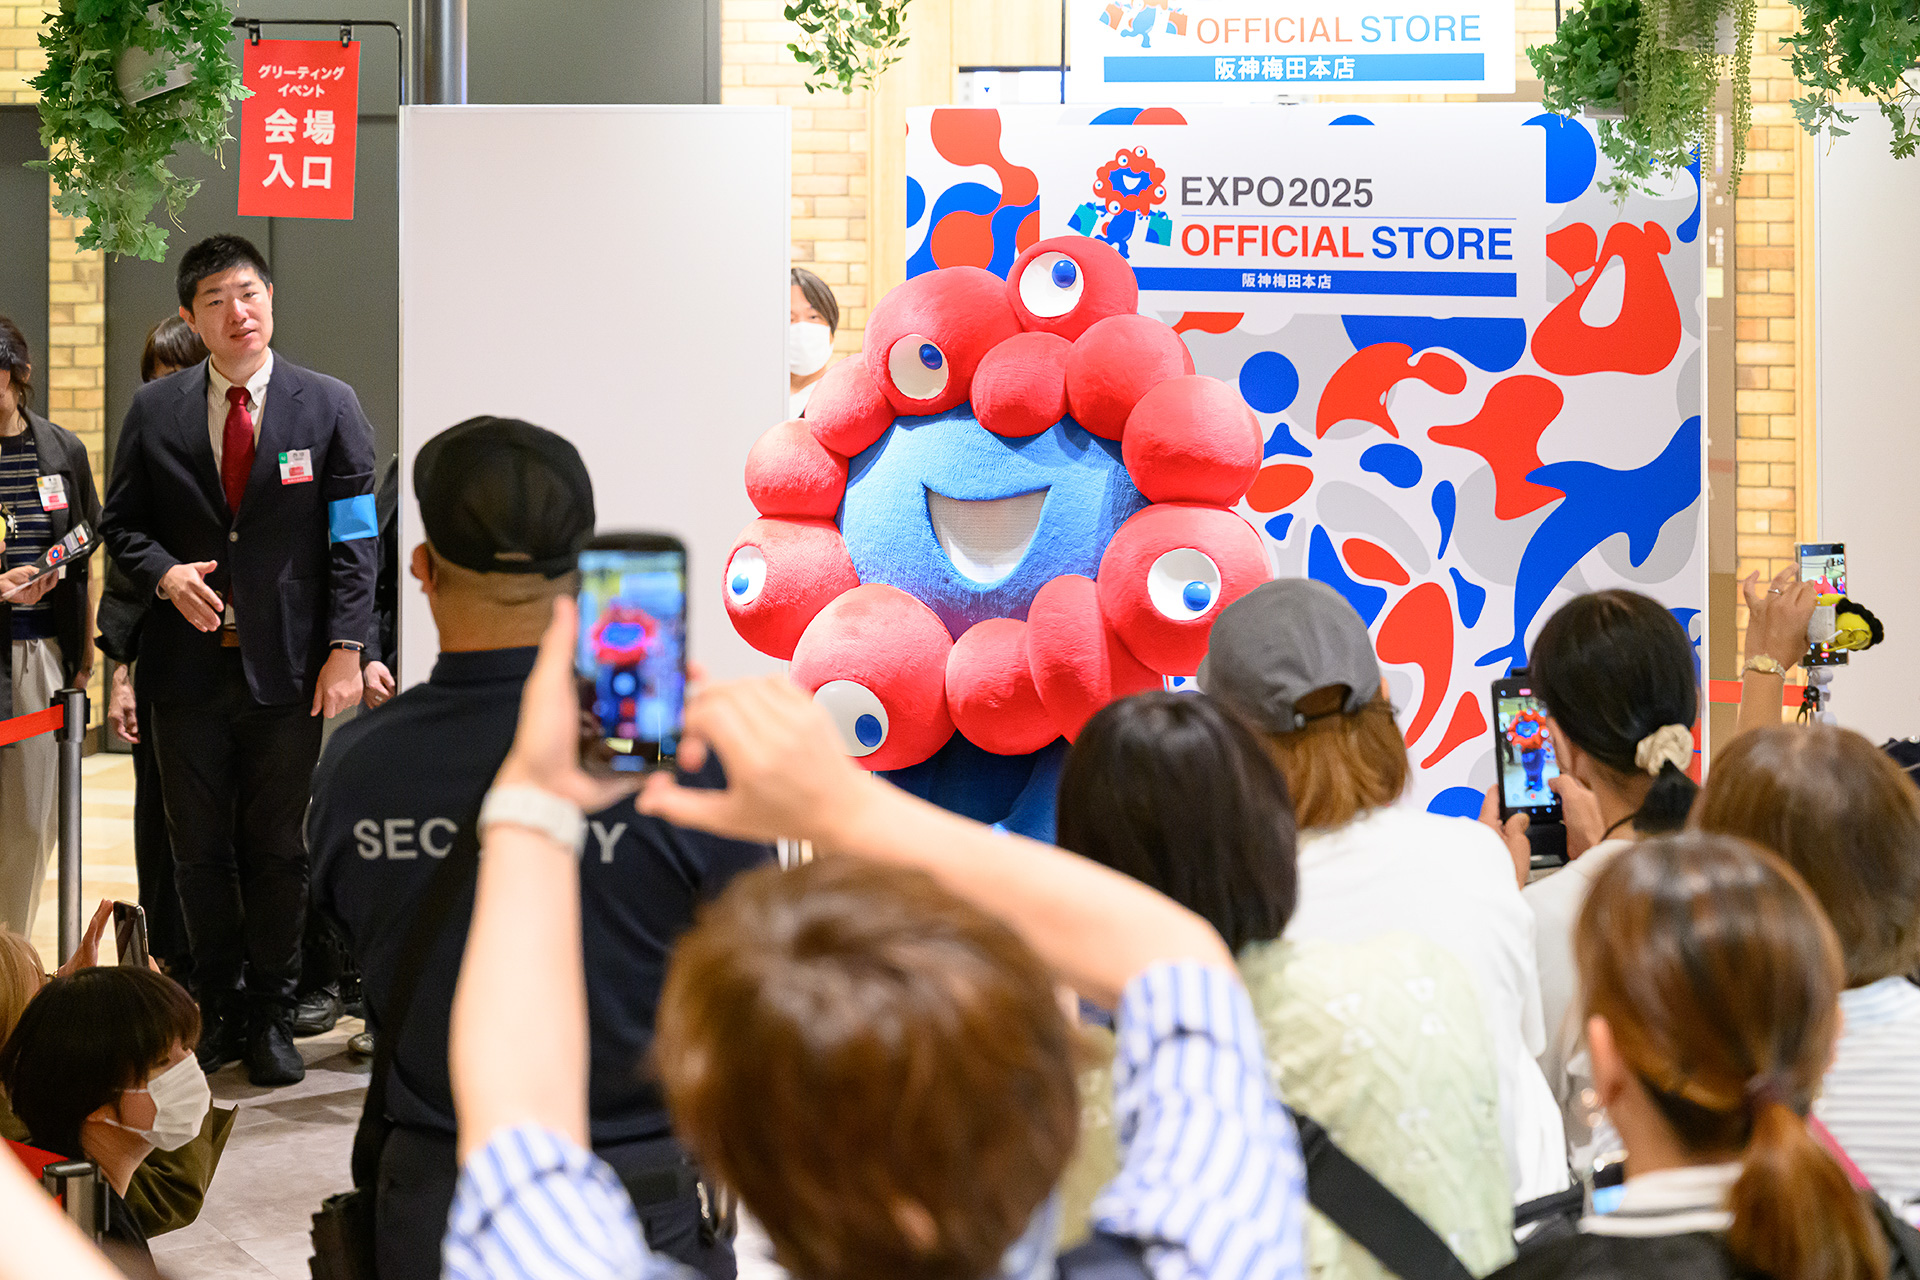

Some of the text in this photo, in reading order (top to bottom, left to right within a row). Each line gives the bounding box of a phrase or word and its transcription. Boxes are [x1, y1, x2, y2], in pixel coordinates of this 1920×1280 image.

[1197, 15, 1480, 44] OFFICIAL STORE
[258, 64, 345, 81] グリーティング
[1214, 56, 1356, 80] 阪神梅田本店
[277, 83, 325, 98] イベント
[264, 108, 336, 145] 会場
[262, 153, 332, 189] 入口
[1181, 176, 1373, 208] EXPO2025
[1181, 224, 1513, 261] OFFICIAL STORE
[1242, 273, 1332, 290] 阪神梅田本店
